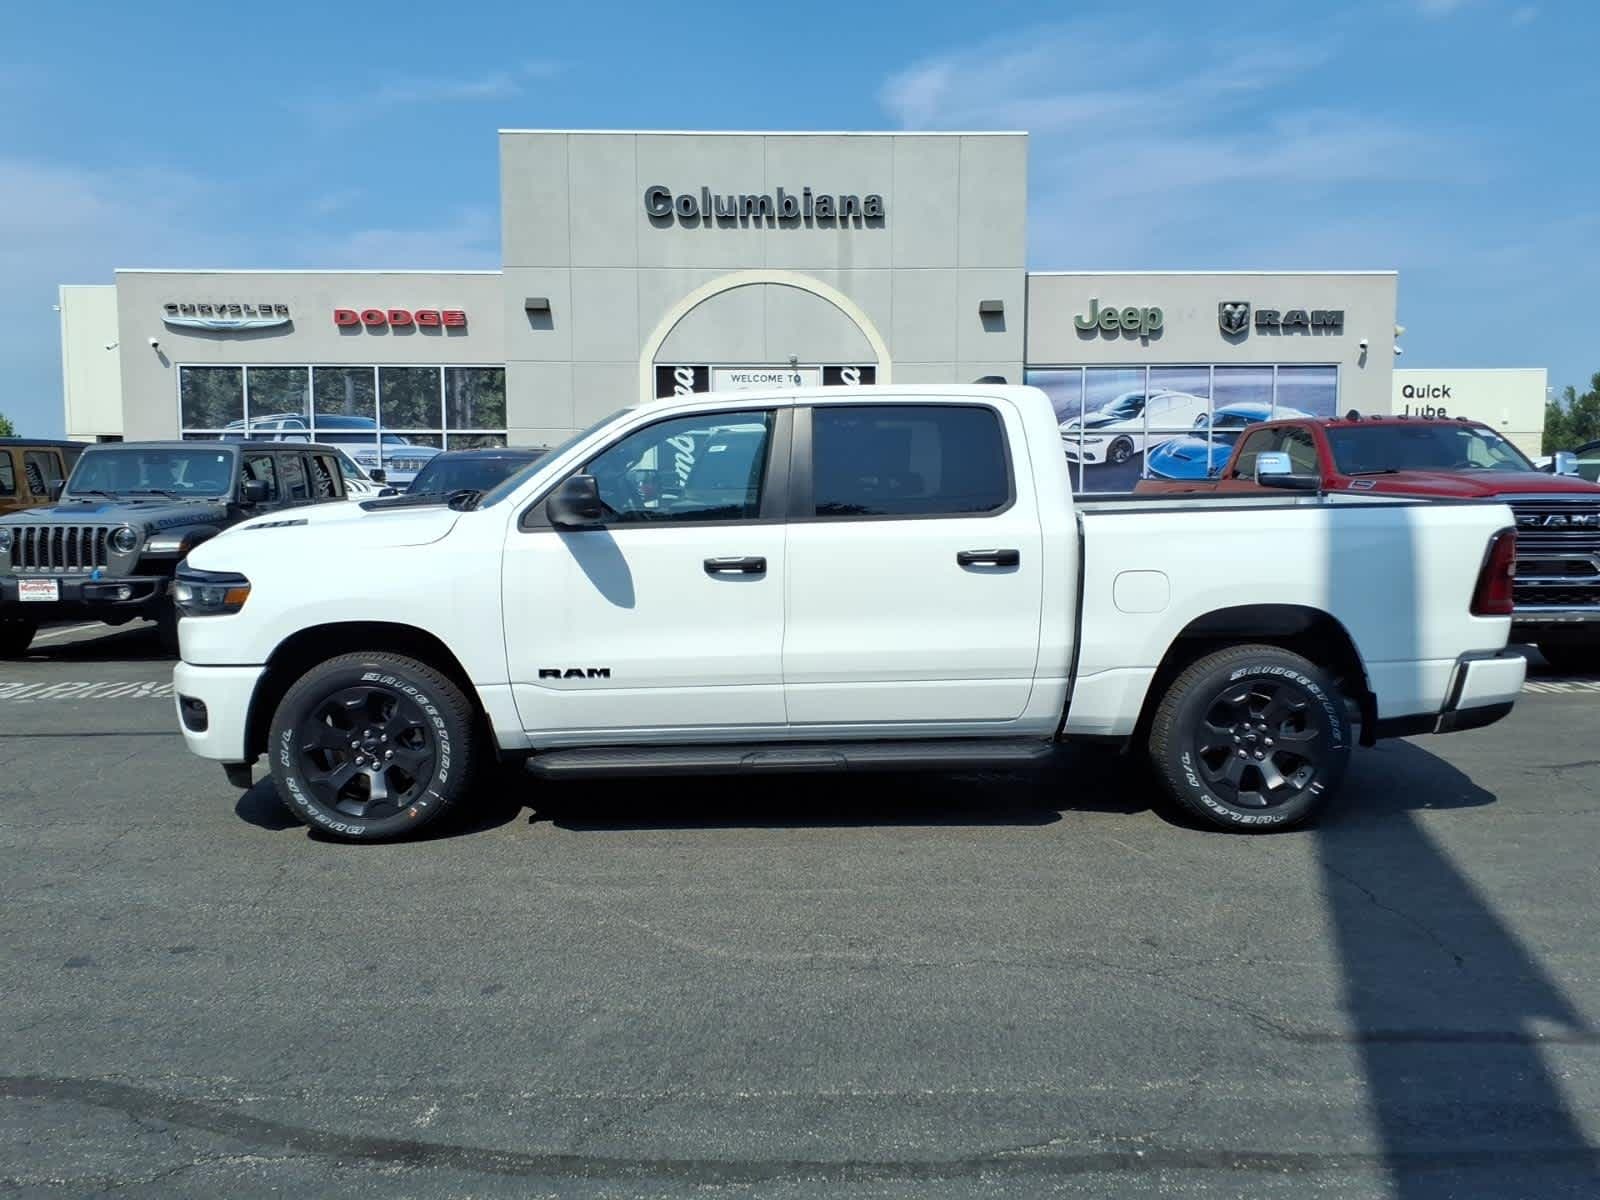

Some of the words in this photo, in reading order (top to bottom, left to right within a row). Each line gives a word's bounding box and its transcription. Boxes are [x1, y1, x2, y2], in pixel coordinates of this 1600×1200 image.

[644, 185, 885, 218] Columbiana
[163, 303, 290, 314] CHRYSLER
[334, 308, 466, 327] DODGE
[1074, 299, 1164, 335] Jeep
[1254, 309, 1345, 326] RAM
[730, 374, 784, 384] WELCOME
[1402, 384, 1452, 399] Quick
[538, 667, 611, 680] RAM
